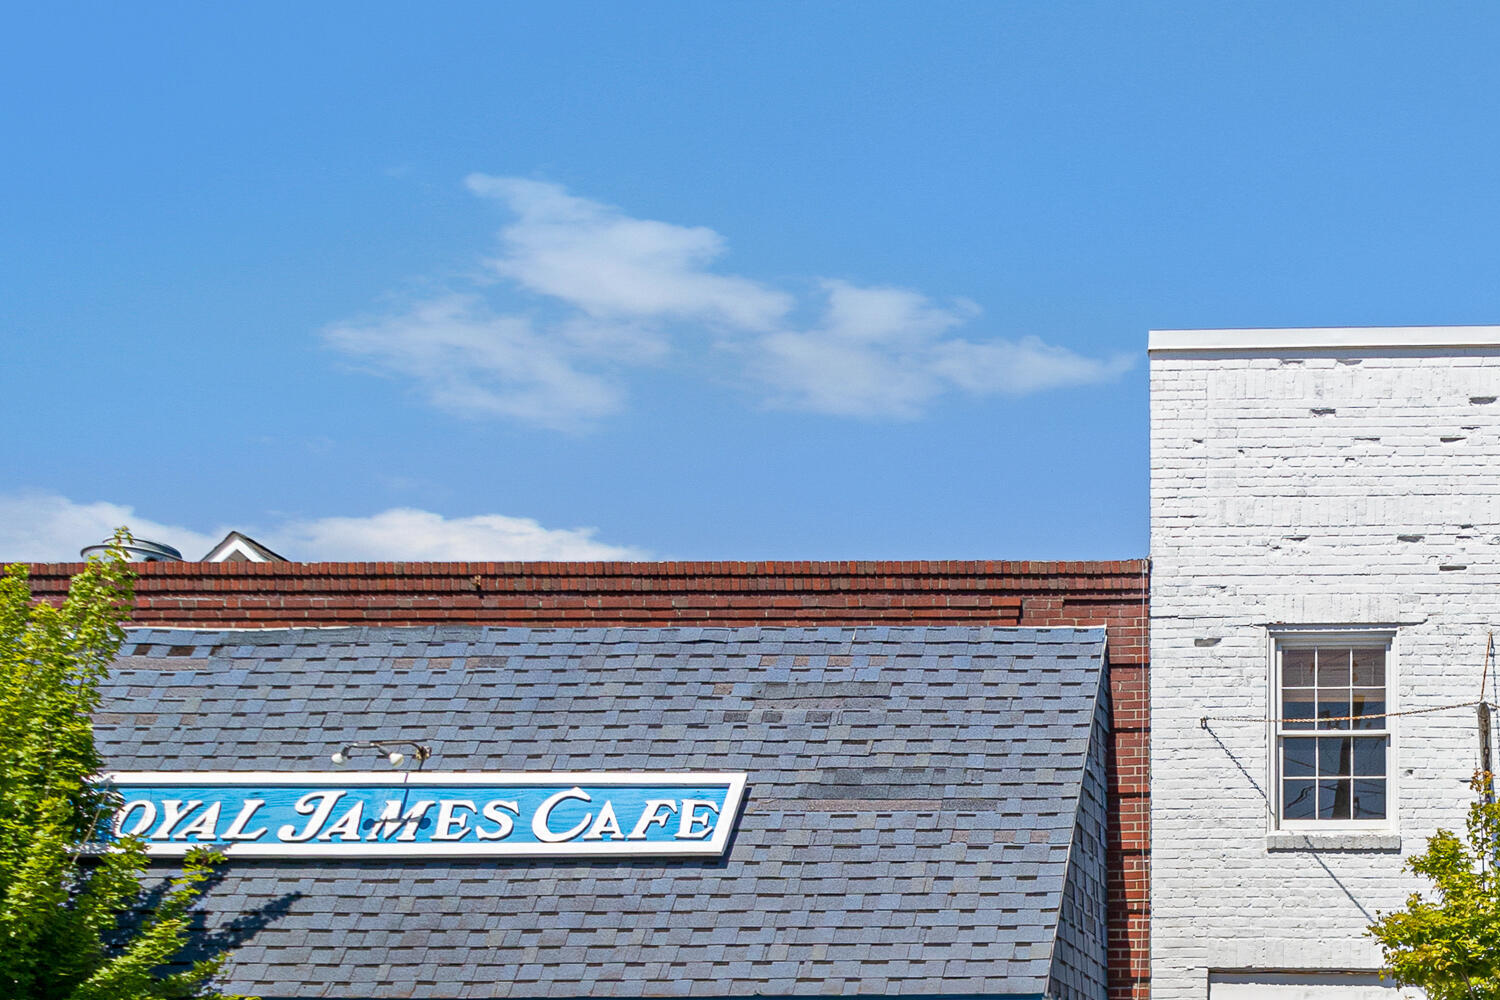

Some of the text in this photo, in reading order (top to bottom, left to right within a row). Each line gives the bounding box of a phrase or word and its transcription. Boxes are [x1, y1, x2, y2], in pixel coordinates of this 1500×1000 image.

[112, 786, 720, 842] OYAL JAMES CAFE
